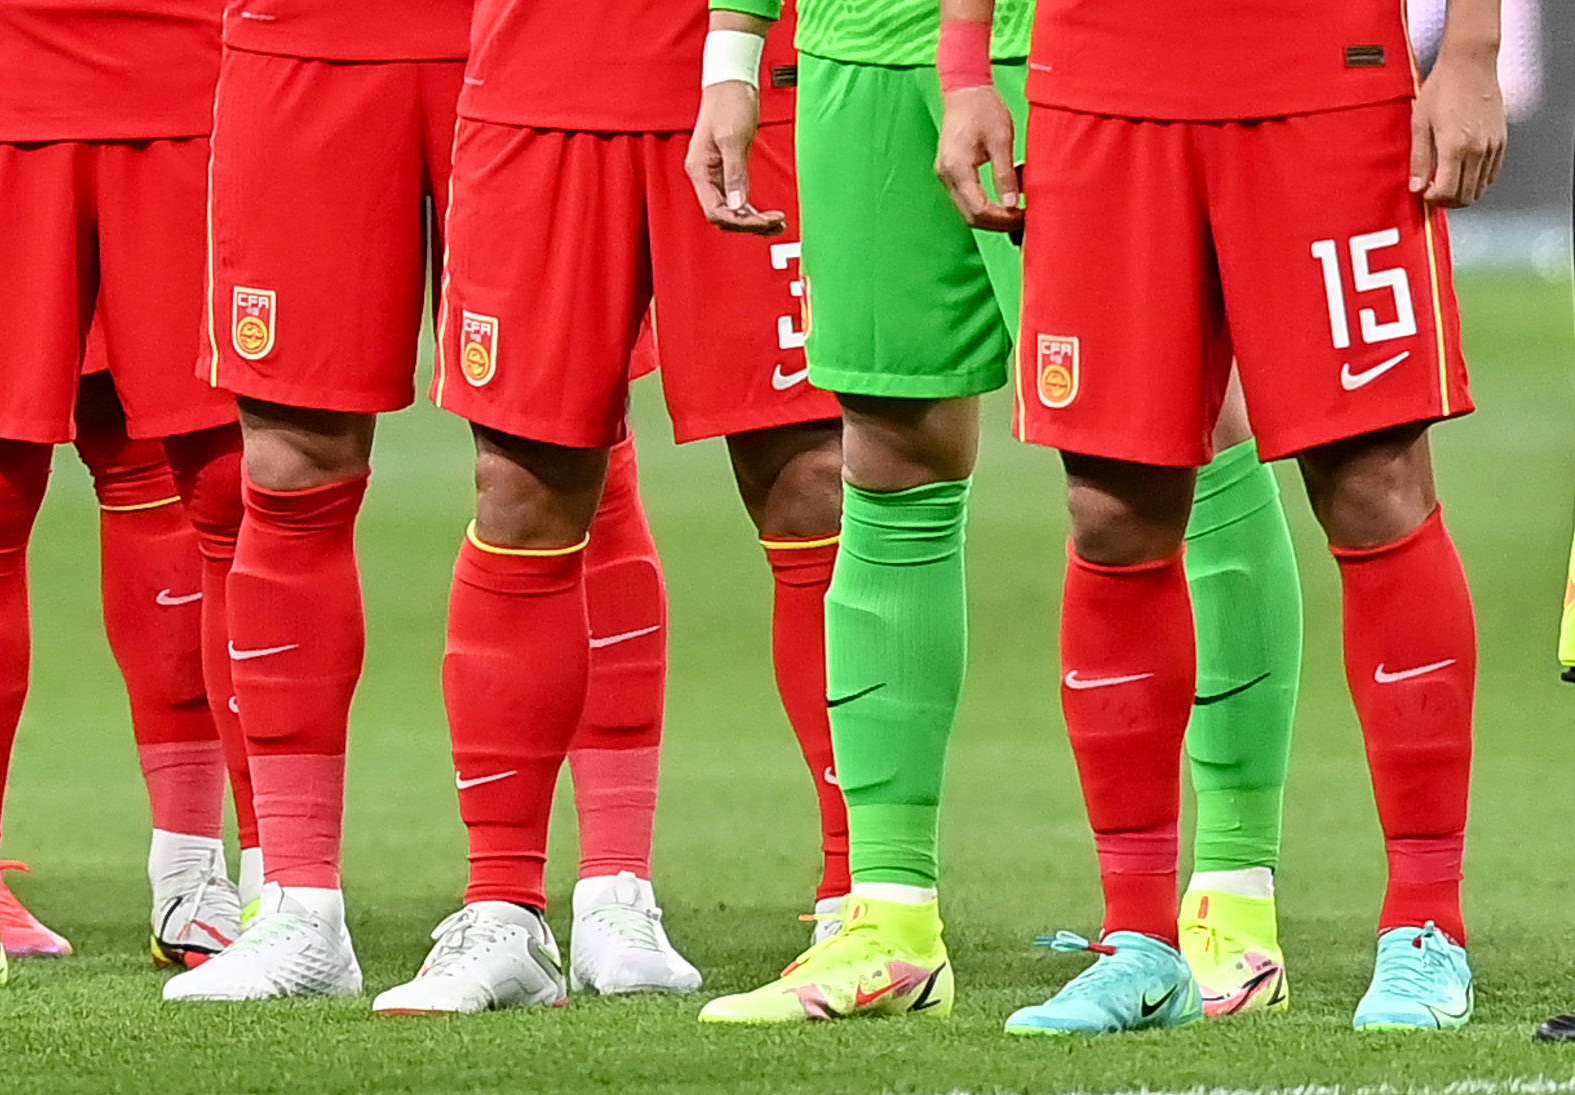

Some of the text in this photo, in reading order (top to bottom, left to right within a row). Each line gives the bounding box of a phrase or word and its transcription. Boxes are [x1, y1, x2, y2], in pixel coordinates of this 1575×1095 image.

[1312, 227, 1418, 349] 15
[237, 293, 269, 309] CFA
[464, 318, 491, 337] CFA
[1041, 341, 1072, 357] CFA
